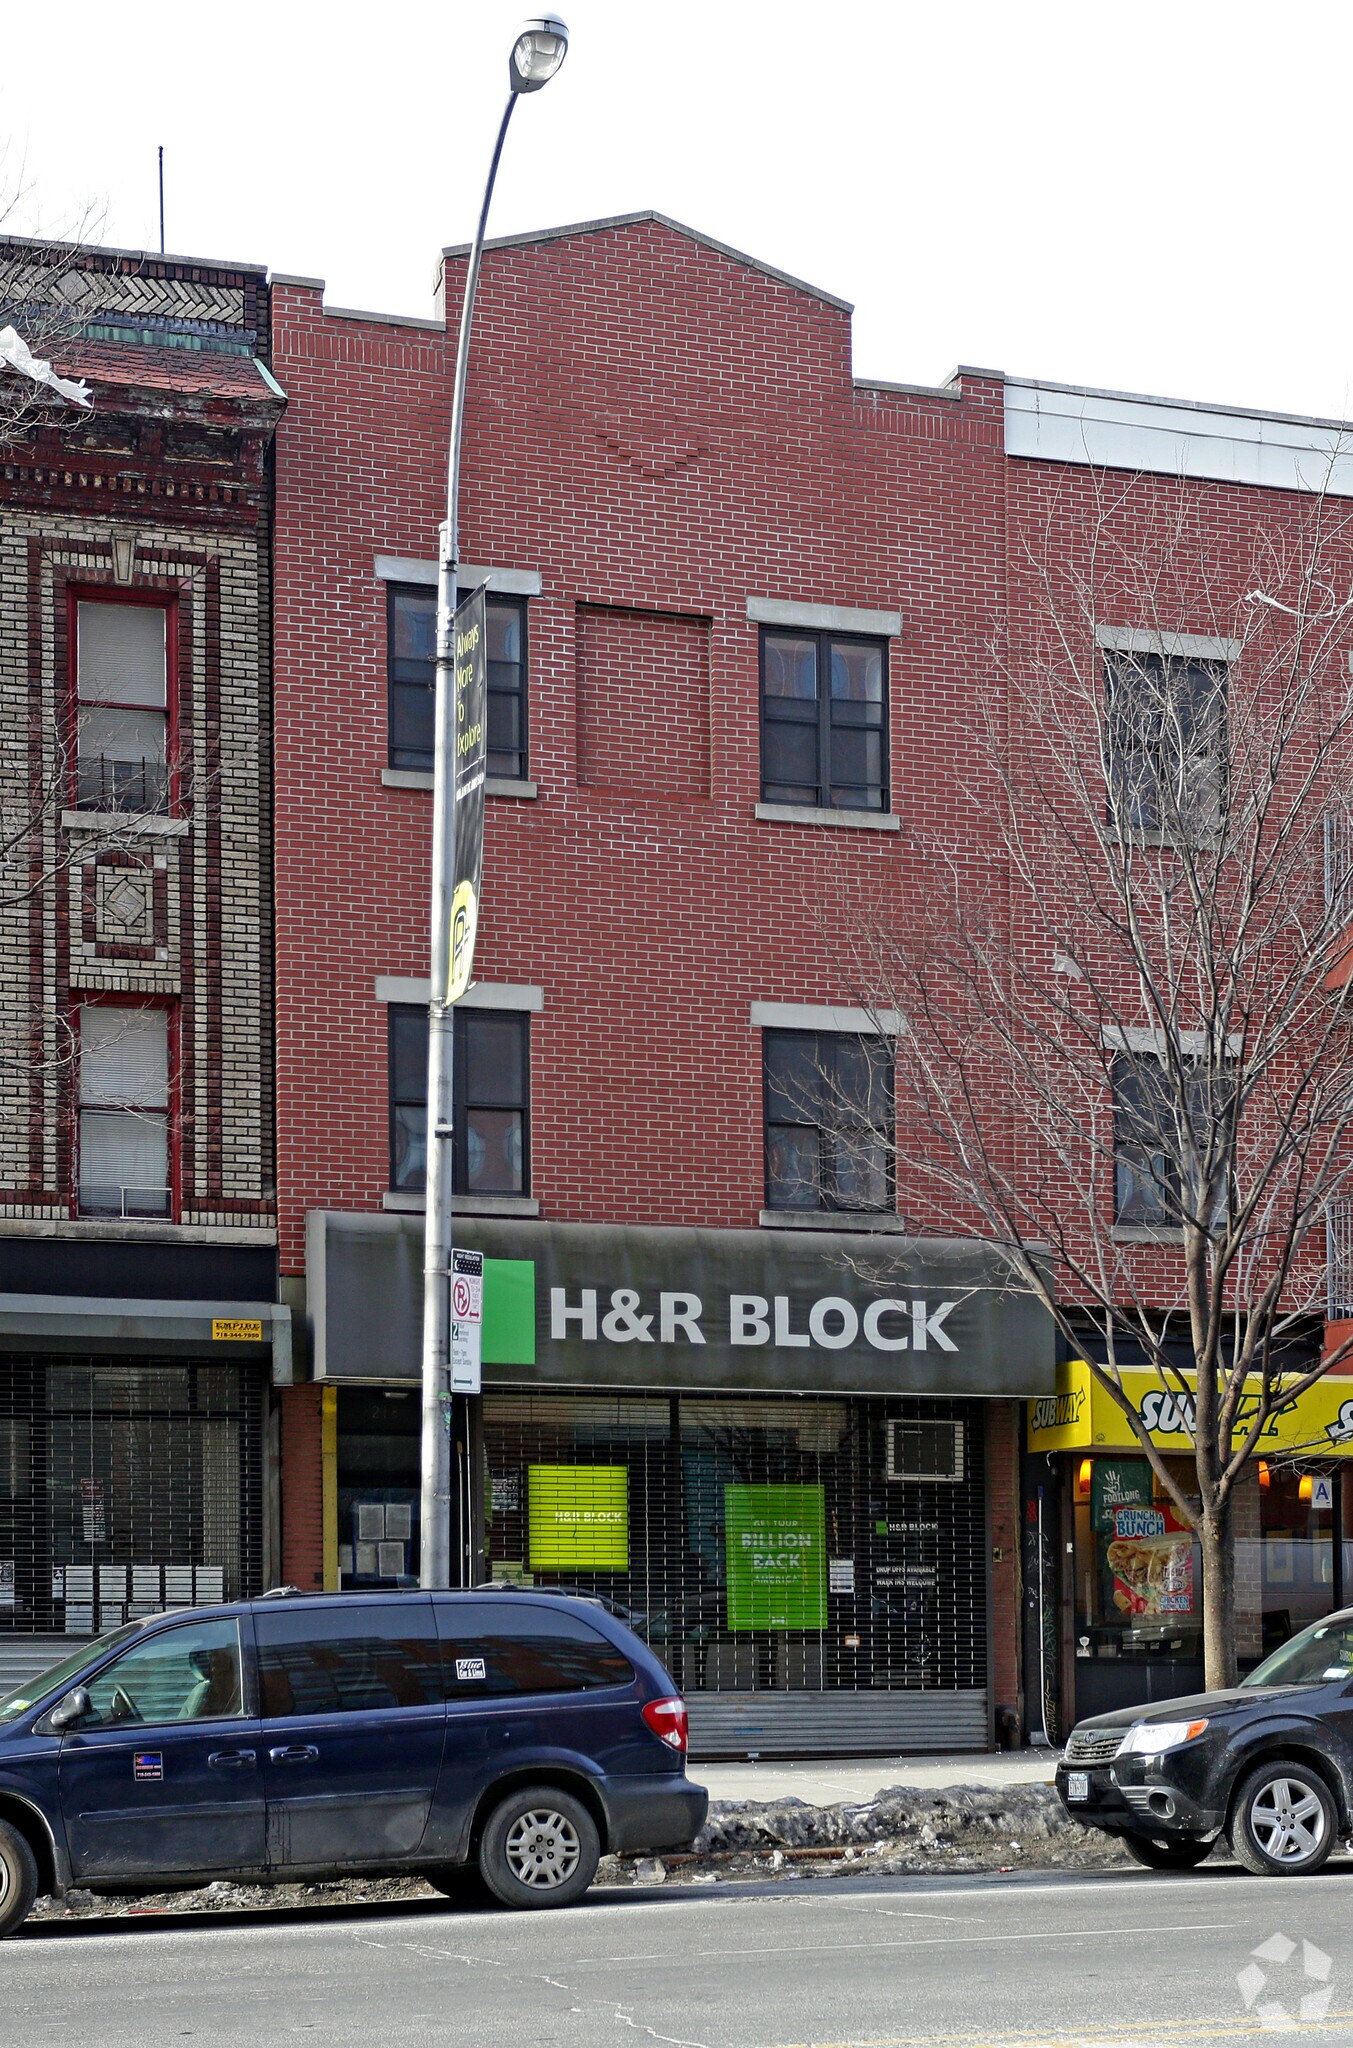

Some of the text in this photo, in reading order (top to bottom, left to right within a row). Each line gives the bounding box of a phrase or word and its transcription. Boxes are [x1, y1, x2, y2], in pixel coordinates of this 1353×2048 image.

[457, 624, 479, 660] Always
[457, 664, 472, 692] More
[458, 724, 481, 758] Explore
[216, 1322, 260, 1330] EMPIRE
[551, 1287, 959, 1352] H&R BLOCK
[452, 1323, 458, 1340] 2
[1031, 1386, 1086, 1433] SUBWAY
[1103, 1489, 1141, 1504] FOOTLONG
[1315, 1482, 1329, 1500] A
[555, 1512, 623, 1523] H&R BLOCK
[1116, 1509, 1155, 1521] CRUNCH
[889, 1523, 938, 1531] H&R BLOCK
[1116, 1521, 1165, 1537] BUNCH
[741, 1533, 812, 1549] BILLION
[753, 1553, 801, 1569] BACK
[459, 1661, 481, 1669] Blue
